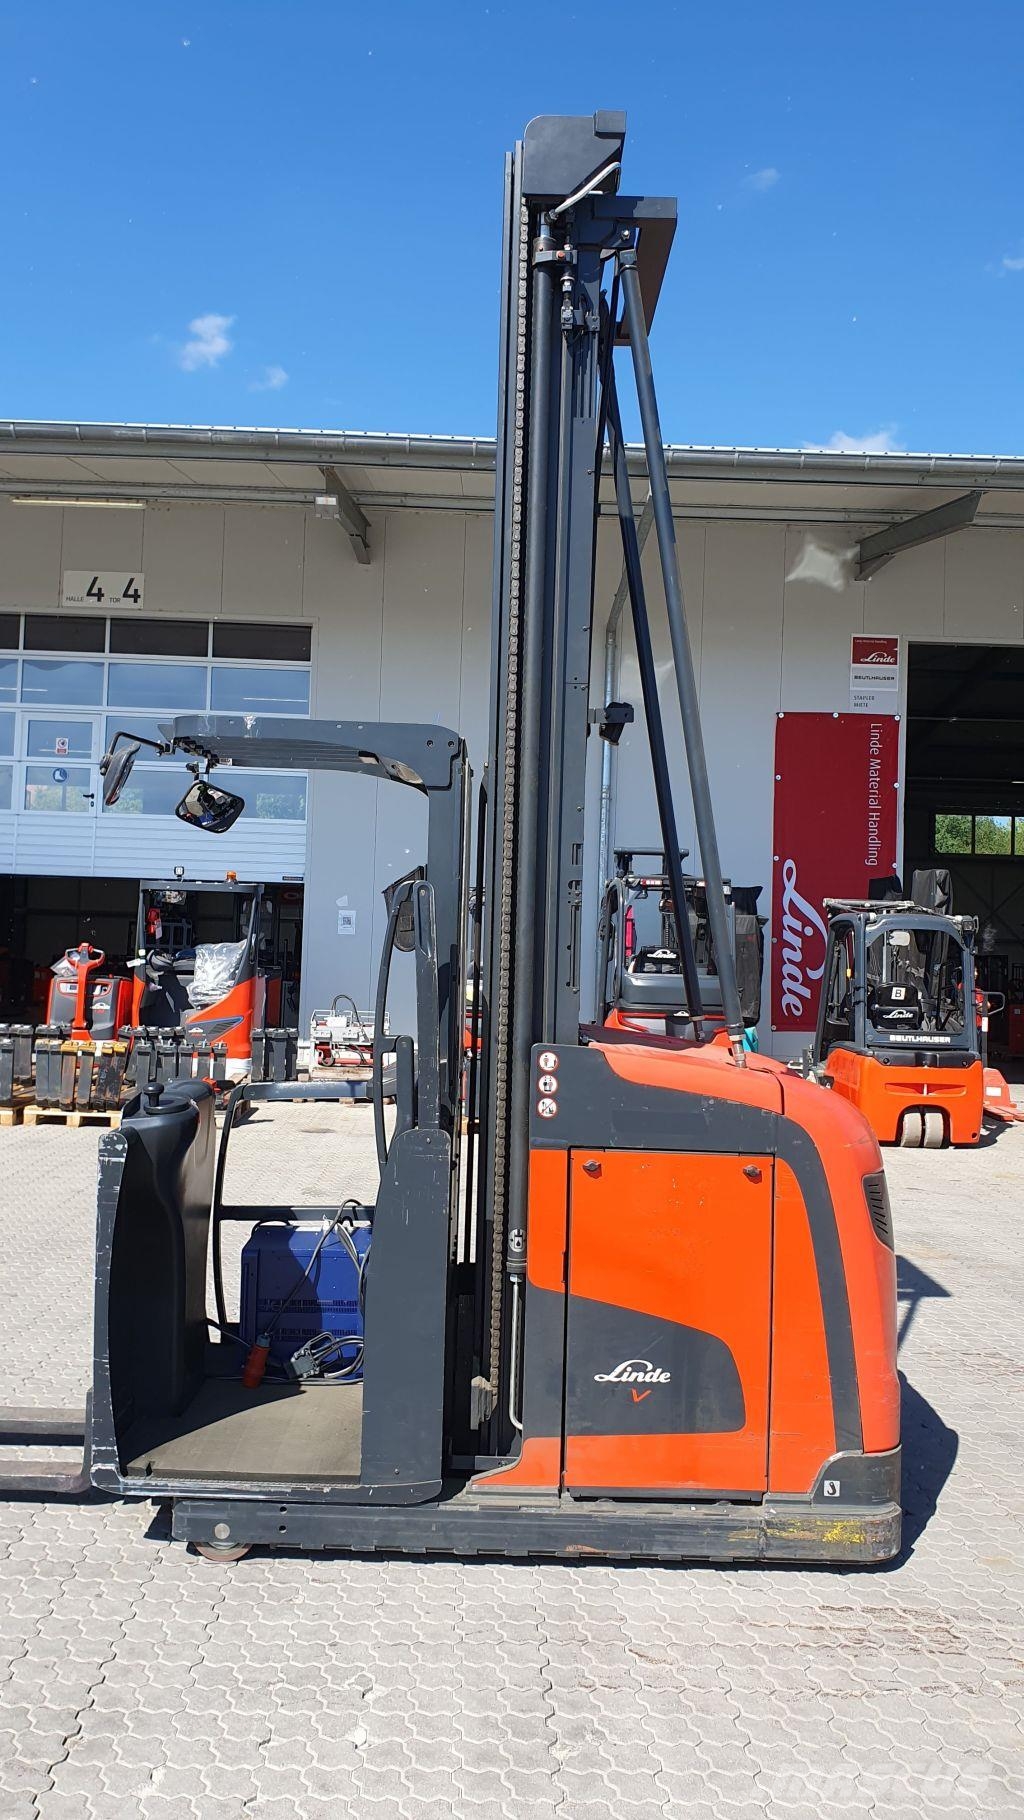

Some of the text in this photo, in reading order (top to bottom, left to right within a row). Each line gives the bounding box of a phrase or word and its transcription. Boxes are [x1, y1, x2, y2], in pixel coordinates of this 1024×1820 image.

[86, 576, 104, 602] 4
[122, 577, 141, 603] 4
[860, 651, 896, 663] Linde
[864, 723, 883, 867] Linde Material Handling
[781, 858, 829, 1017] Linde
[882, 1009, 914, 1019] Linde
[889, 1034, 951, 1044] BEUTLHAUSER
[593, 1359, 671, 1383] Linde
